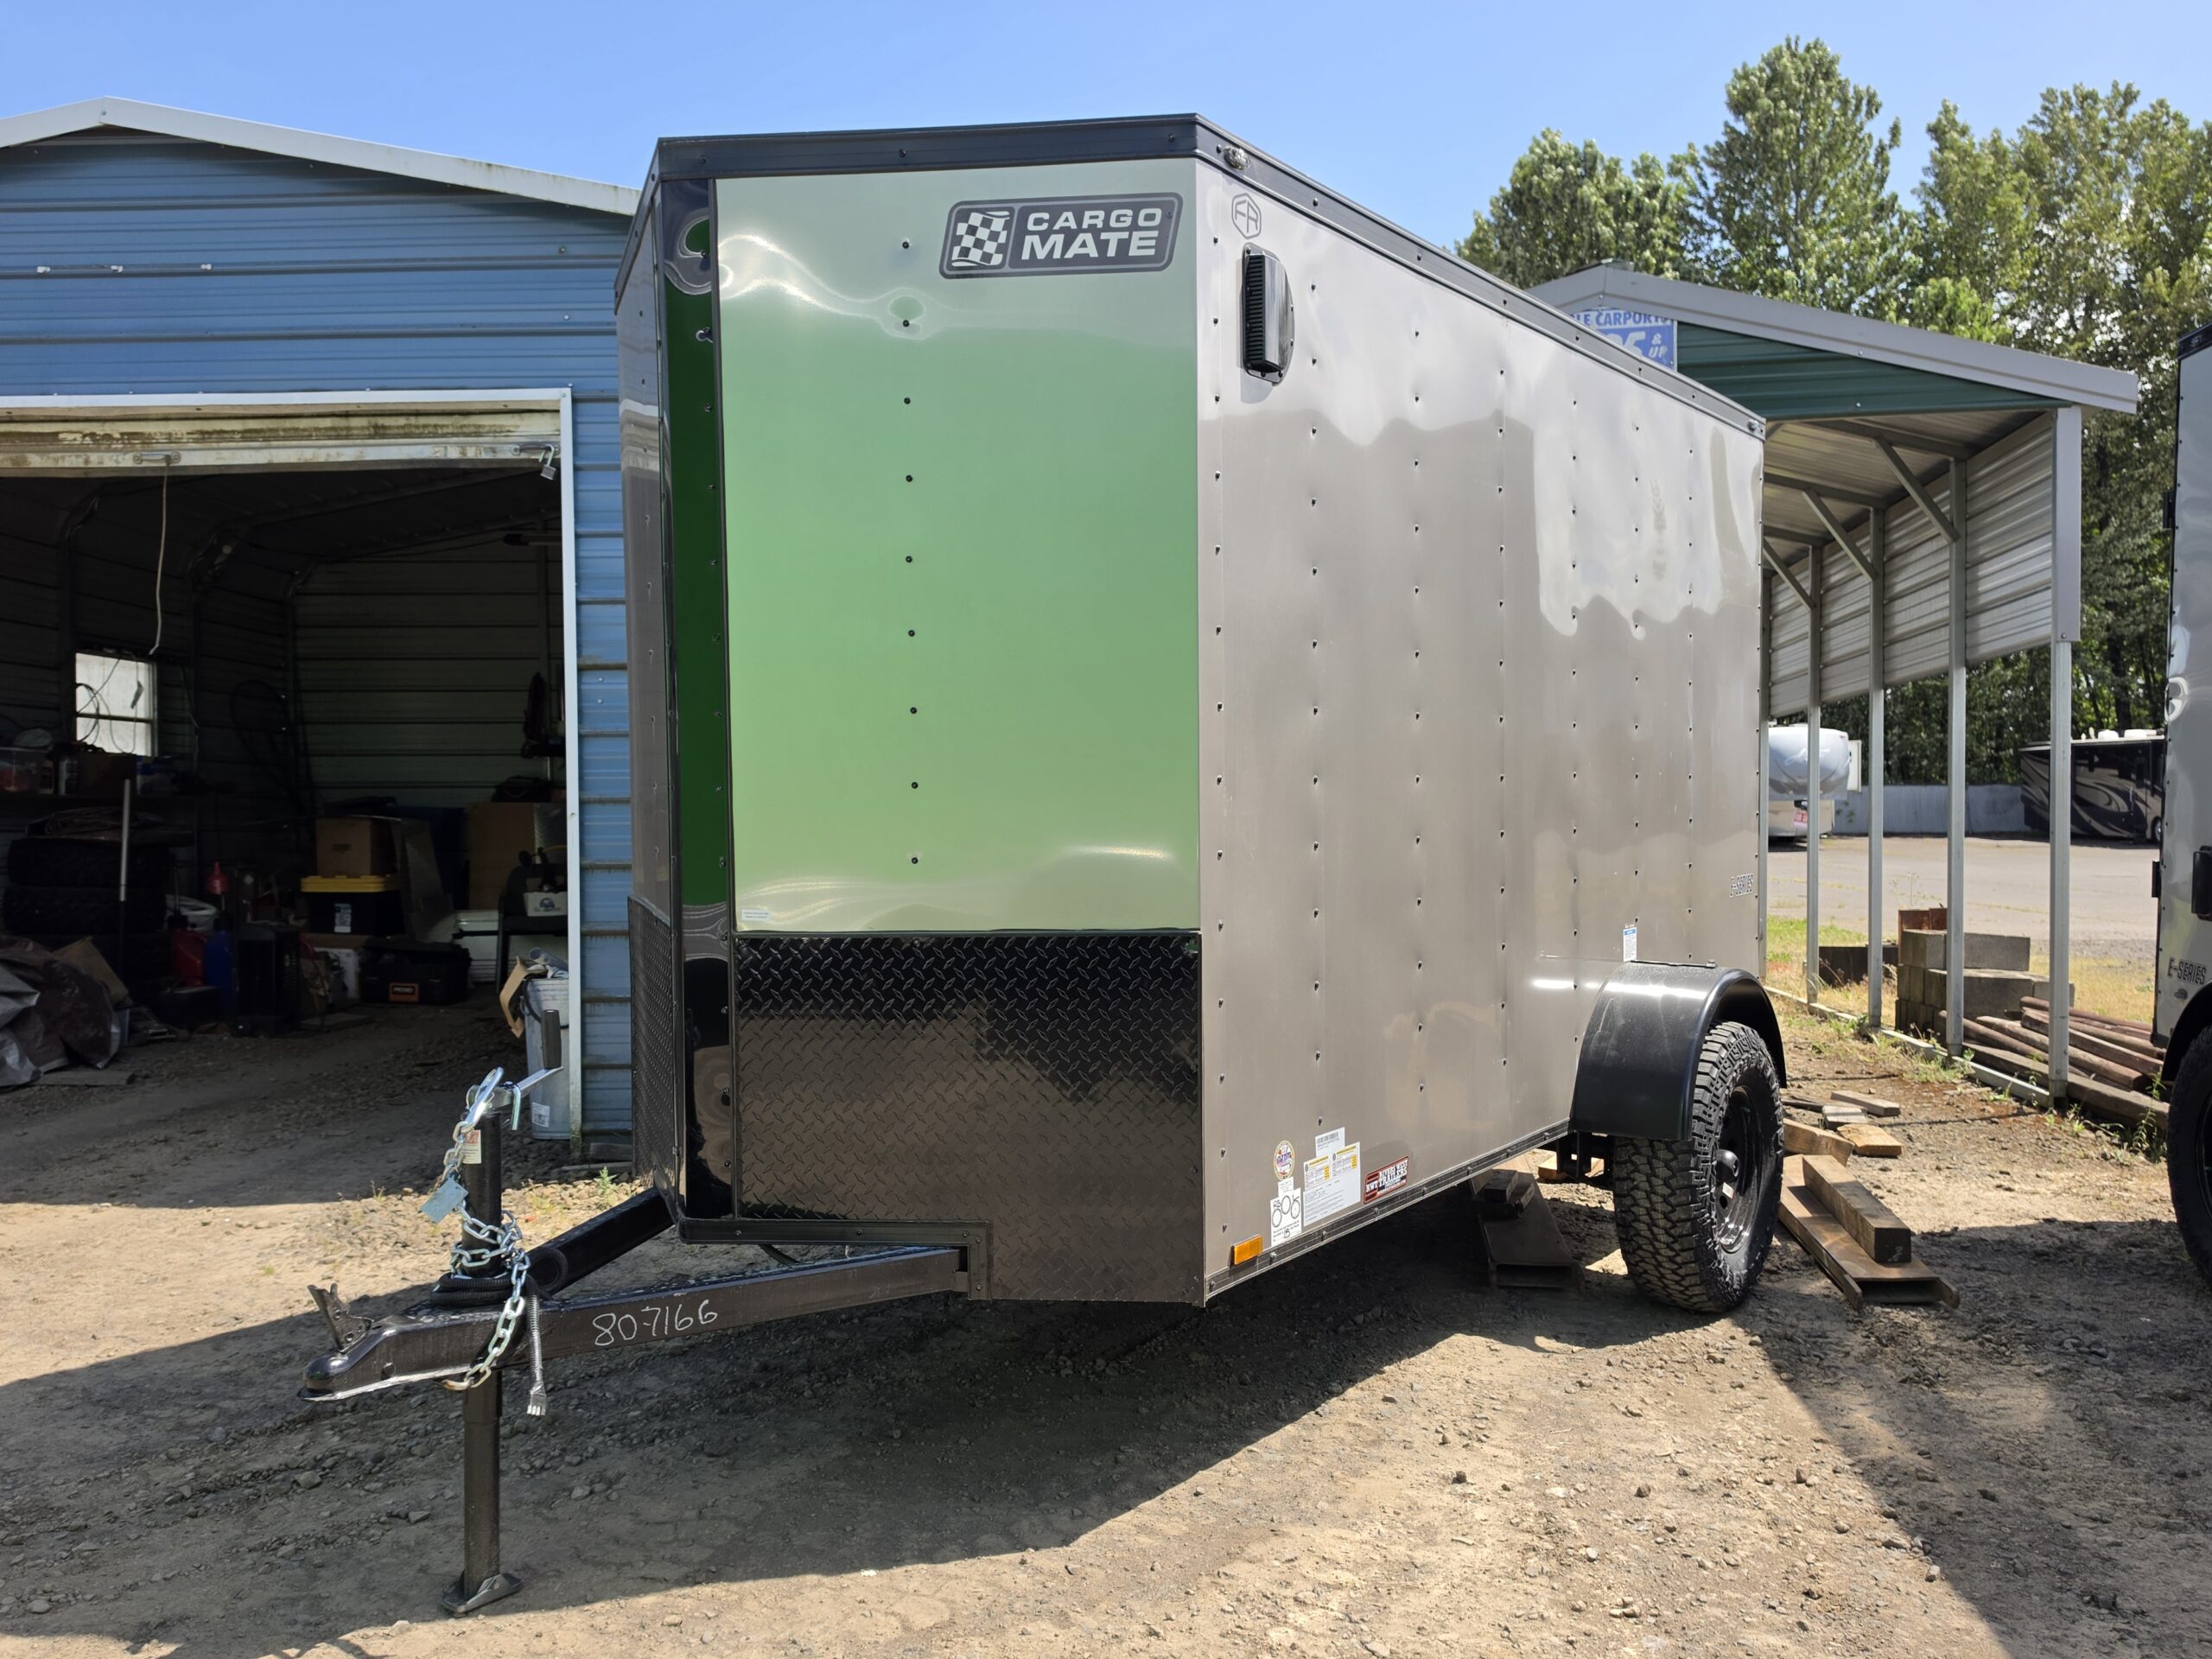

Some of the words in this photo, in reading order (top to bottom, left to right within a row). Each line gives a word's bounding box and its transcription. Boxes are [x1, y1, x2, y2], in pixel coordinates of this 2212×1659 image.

[1027, 208, 1162, 232] CARGO
[1021, 230, 1159, 261] MATE
[2167, 957, 2207, 986] E-SERIES
